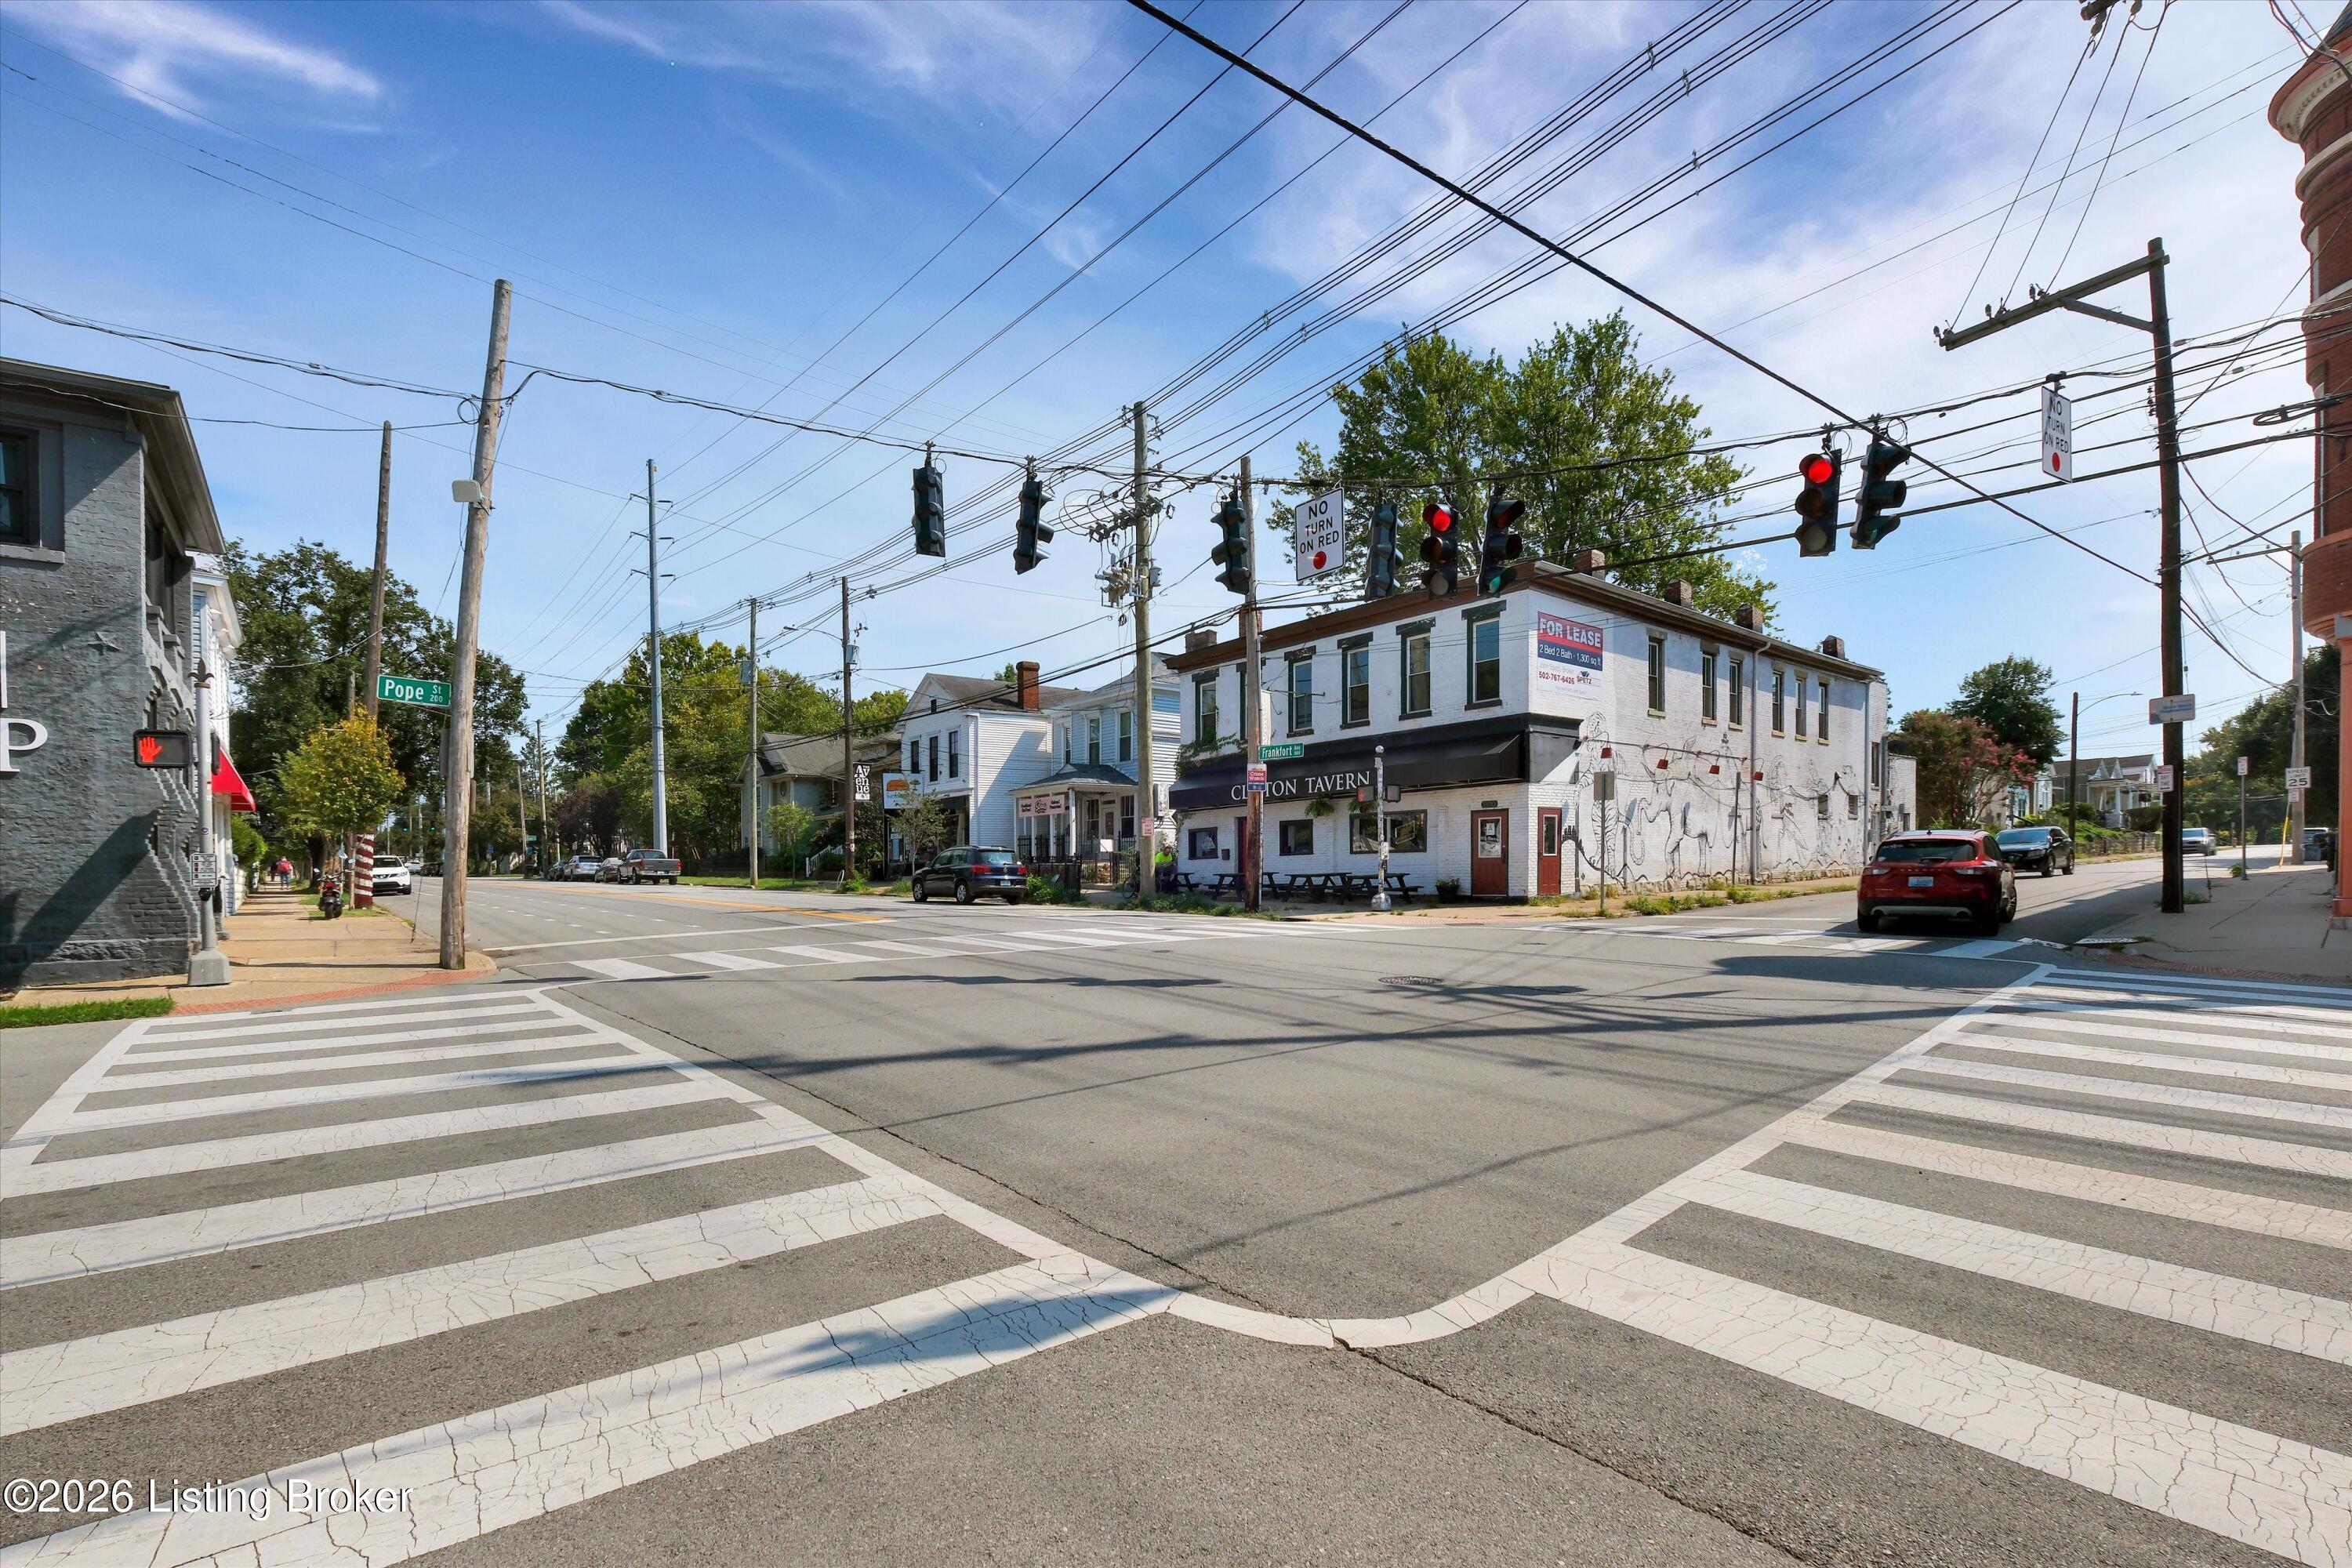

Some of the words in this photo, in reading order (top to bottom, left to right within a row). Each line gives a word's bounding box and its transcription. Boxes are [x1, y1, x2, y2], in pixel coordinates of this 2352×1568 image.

[2049, 396, 2062, 416] NO
[2047, 416, 2065, 435] TURN
[2044, 430, 2053, 447] ON
[2055, 437, 2069, 453] RED
[1308, 500, 1328, 520] NO
[1305, 517, 1333, 536] TURN
[1299, 539, 1314, 554] ON
[1318, 530, 1339, 548] RED
[1540, 618, 1563, 637] FOR
[1566, 626, 1601, 647] LEASE
[1539, 644, 1544, 653] 2
[1544, 645, 1555, 655] Bed
[1555, 648, 1561, 657] 2
[1560, 649, 1573, 659] Bath
[1577, 653, 1590, 663] 1,300
[1590, 657, 1597, 666] sq
[432, 684, 442, 695] St
[1577, 675, 1592, 684] SPETZ
[384, 679, 424, 701] Pope
[1262, 746, 1292, 758] Frankfort
[1231, 779, 1298, 800] CLTON
[1305, 771, 1370, 793] TAVERN
[2288, 778, 2307, 787] 25
